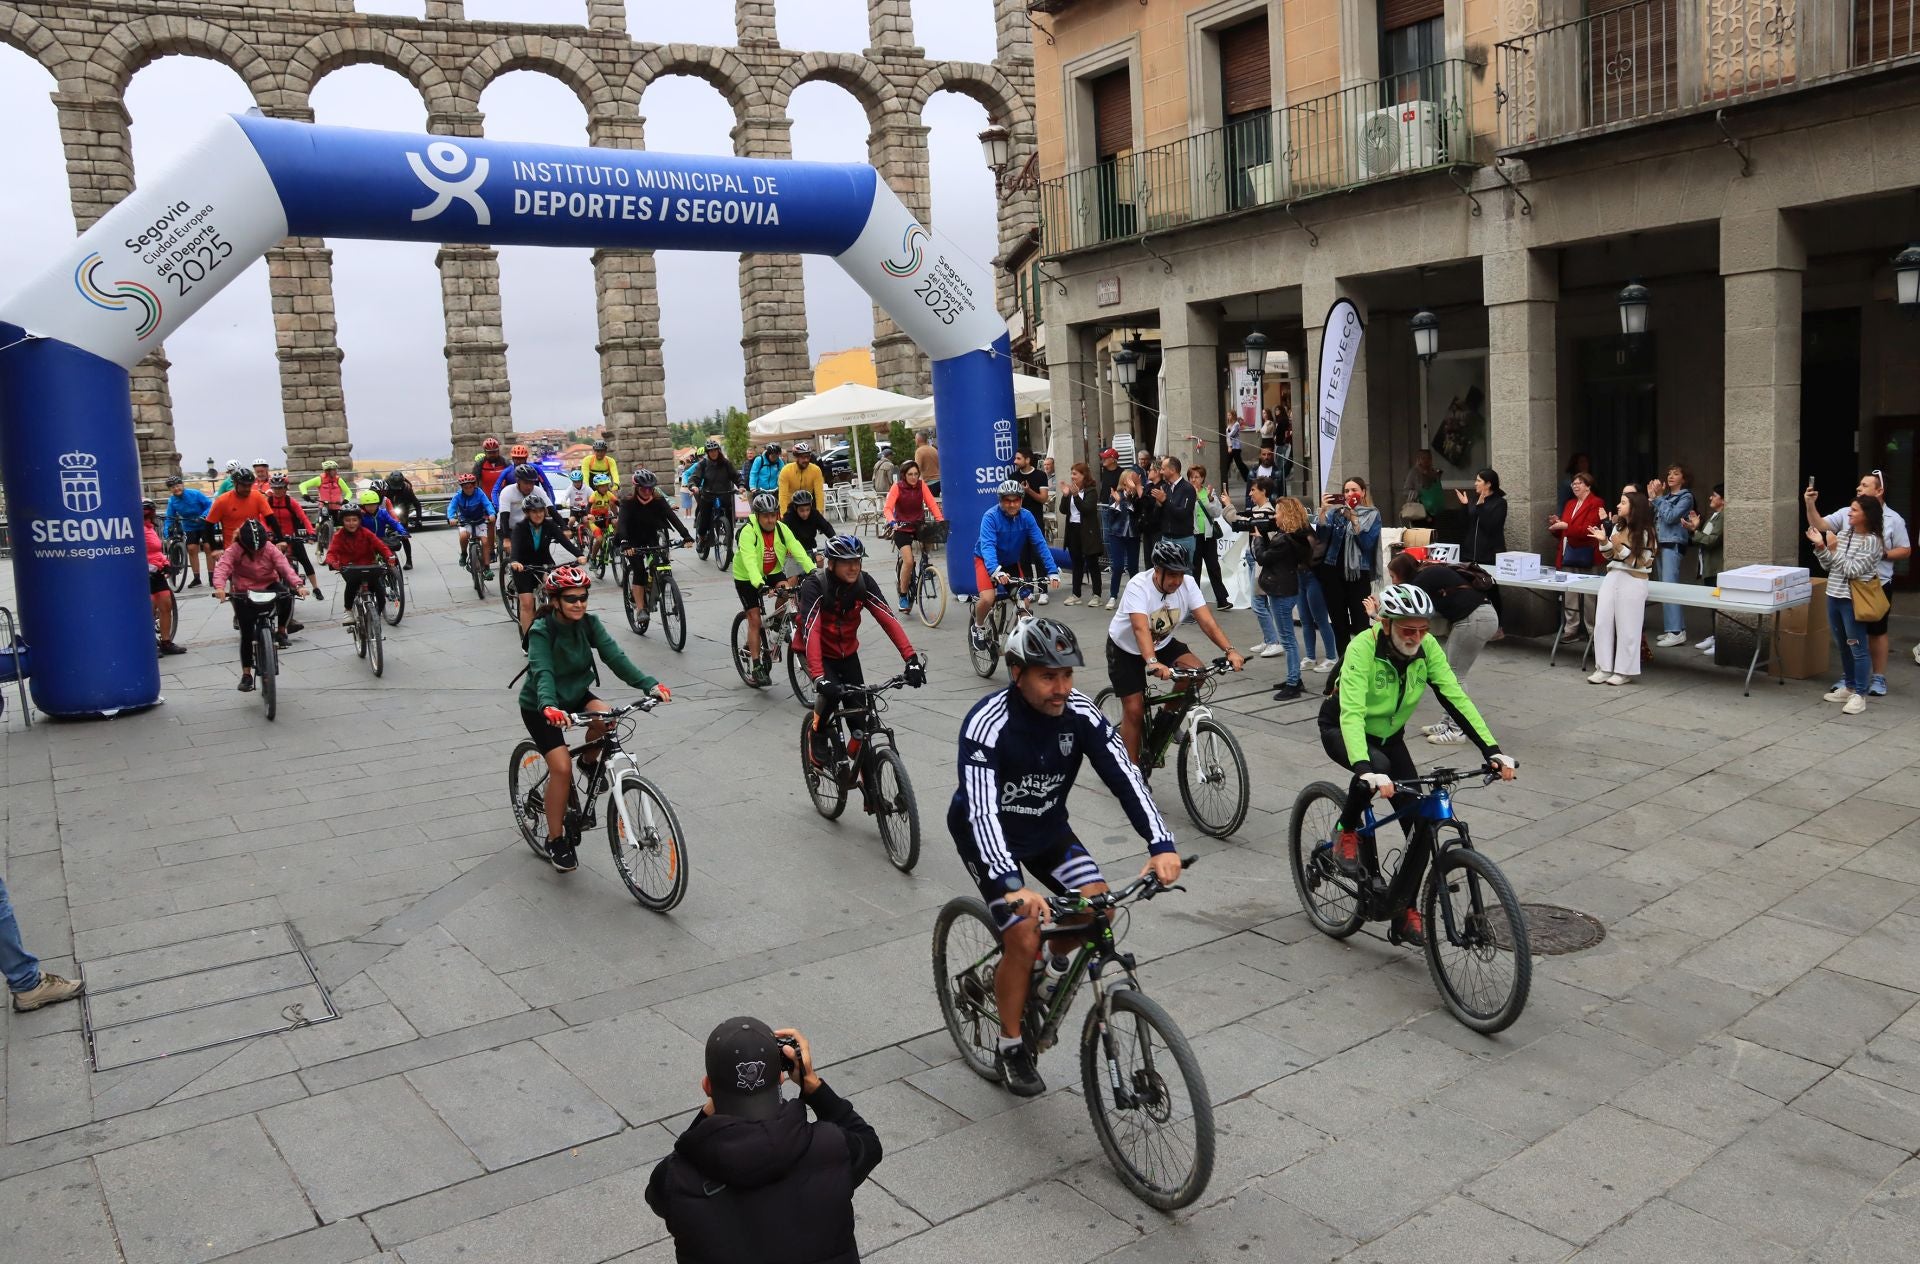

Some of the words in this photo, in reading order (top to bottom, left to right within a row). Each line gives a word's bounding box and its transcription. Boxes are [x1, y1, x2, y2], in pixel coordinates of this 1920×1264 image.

[513, 161, 629, 187] INSTITUTO
[637, 170, 749, 194] MUNICIPAL
[753, 176, 779, 195] DE
[125, 200, 191, 254] Segovia
[514, 189, 653, 221] DEPORTES
[675, 198, 780, 226] SEGOVIA
[142, 234, 178, 265] Ciudad
[173, 204, 214, 238] Europea
[157, 258, 175, 277] del
[170, 225, 216, 263] Deporte
[167, 233, 233, 296] 2025
[938, 255, 973, 297] Segovia
[914, 280, 960, 325] 2025
[928, 273, 940, 285] del
[938, 282, 964, 312] Deporte
[934, 264, 954, 287] Ciudad
[953, 284, 976, 312] Europea
[1326, 311, 1355, 401] TESVECO
[975, 465, 1017, 483] SEGO
[32, 517, 134, 543] SEGOVIA
[34, 545, 135, 560] www.segovia.es
